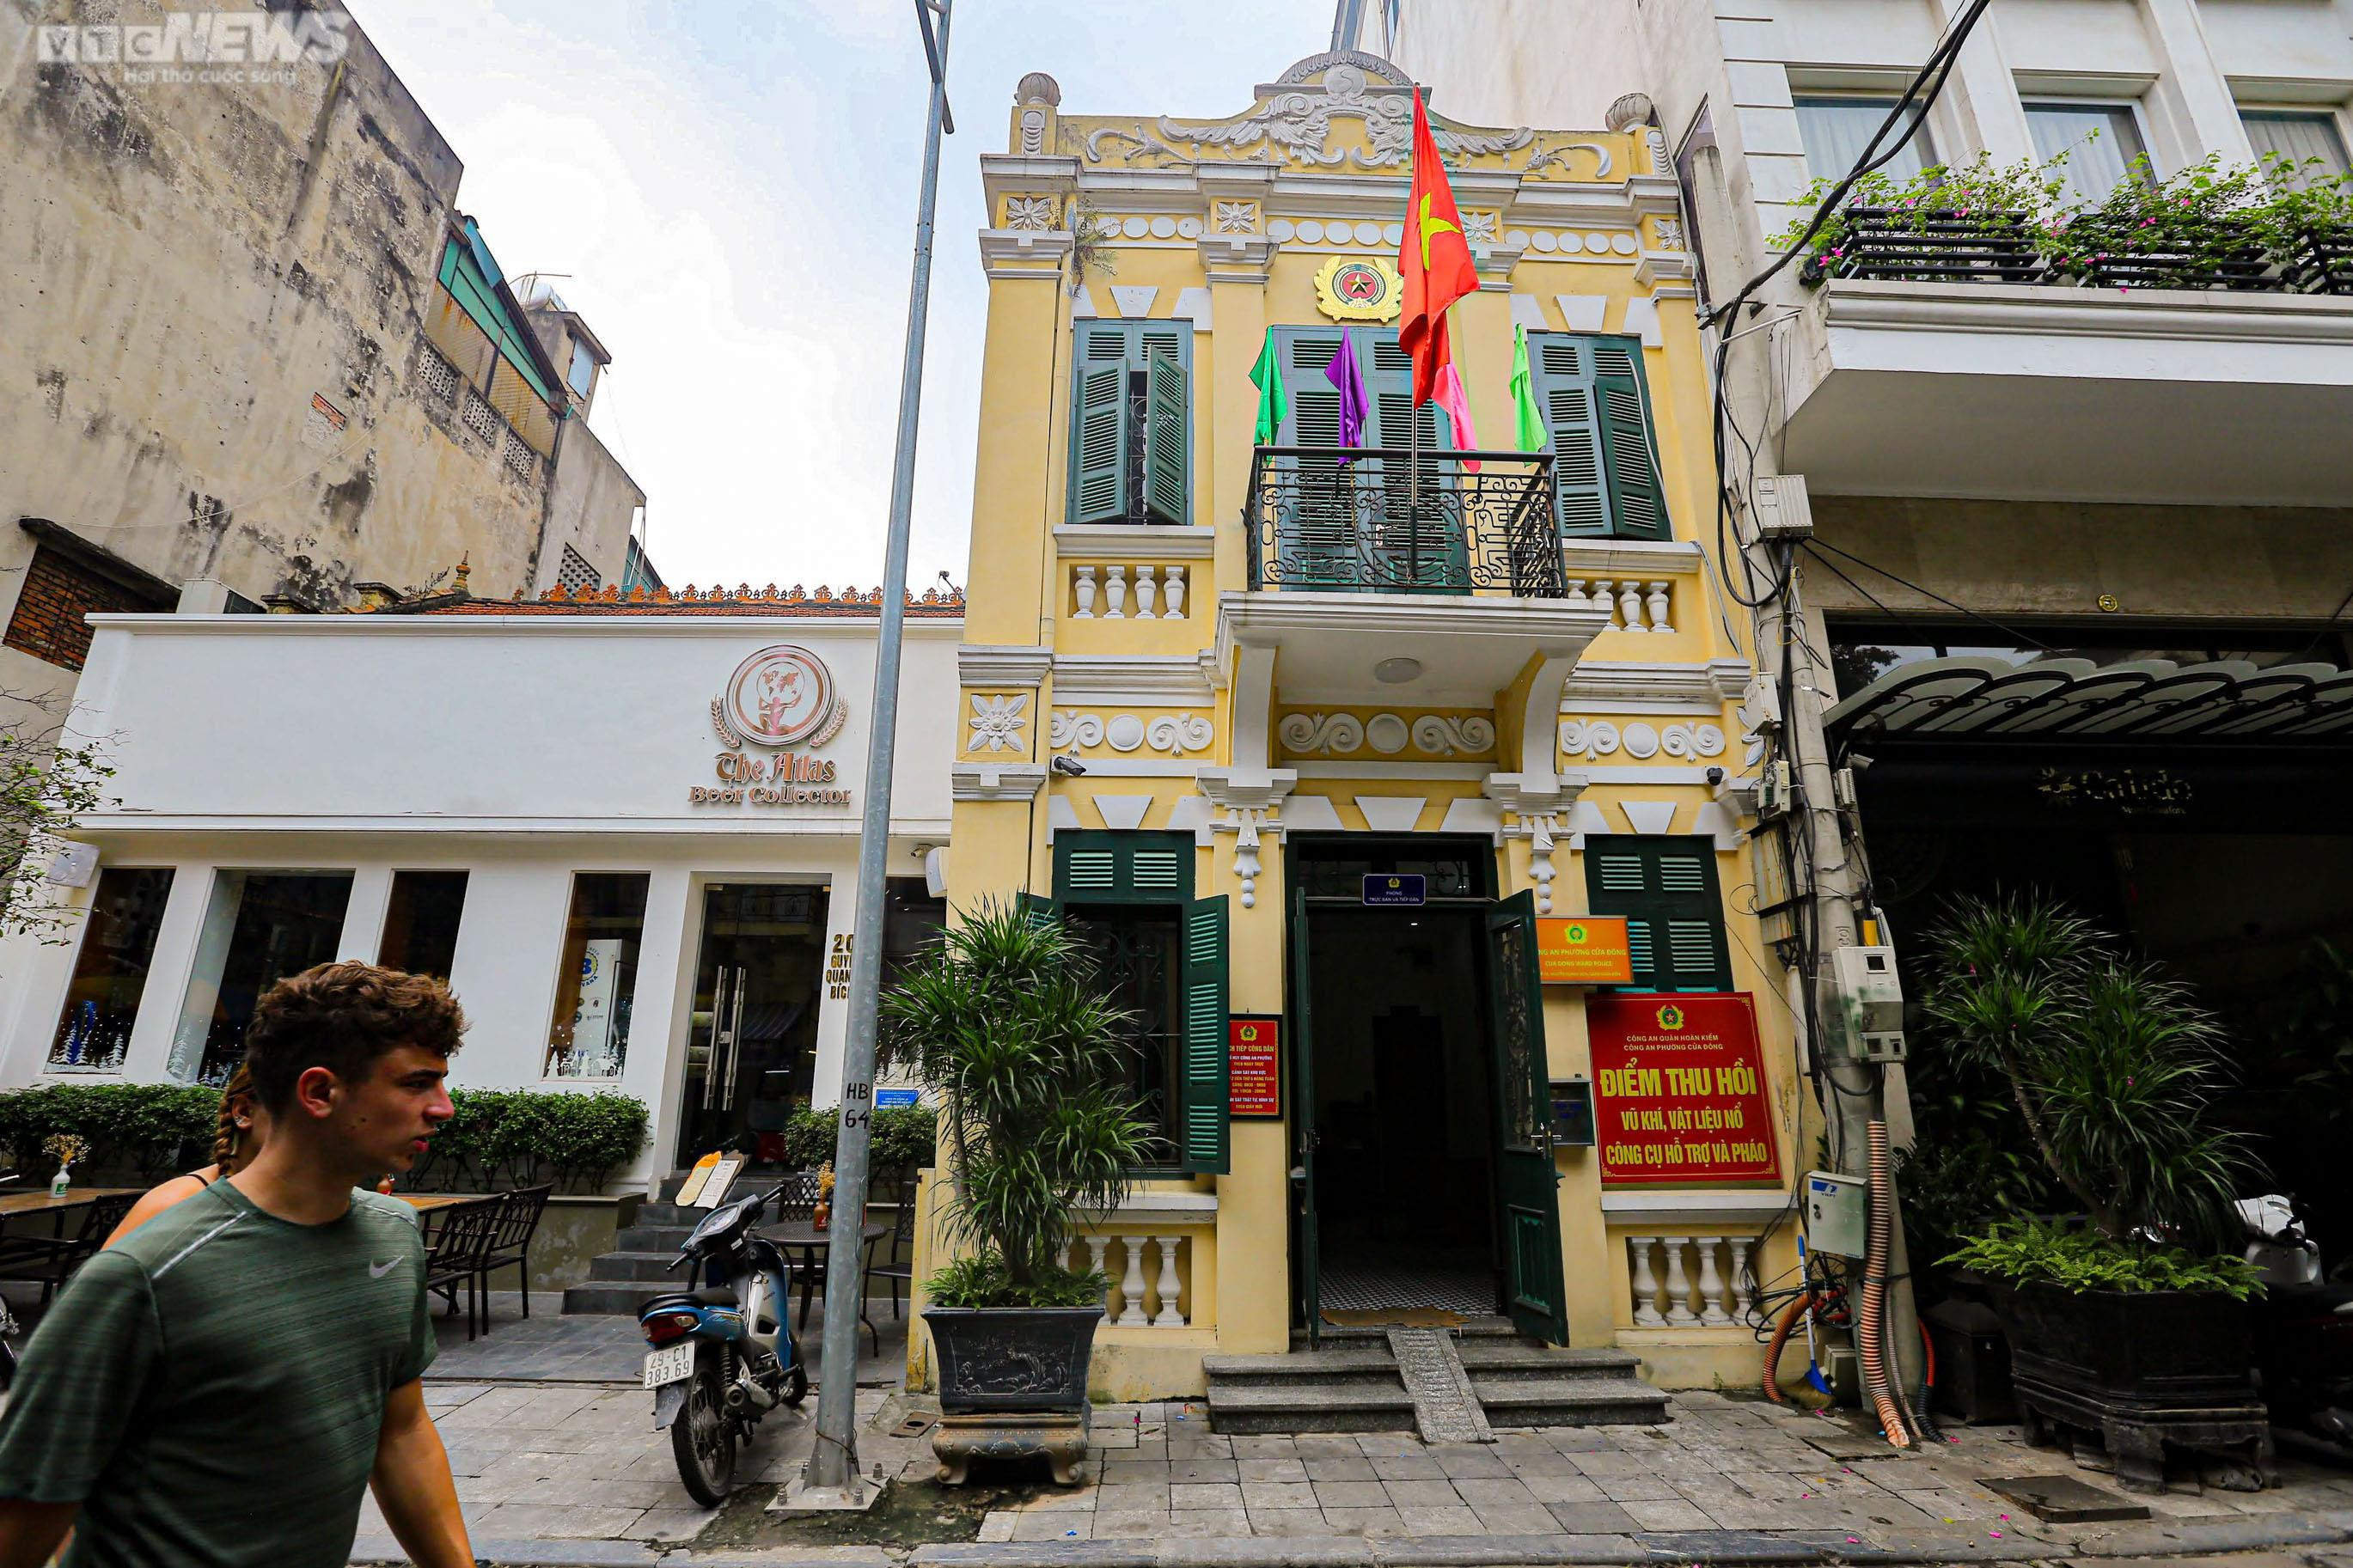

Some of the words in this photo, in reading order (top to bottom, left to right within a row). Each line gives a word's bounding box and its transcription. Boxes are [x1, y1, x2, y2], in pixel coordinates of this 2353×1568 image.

[714, 751, 766, 789] The
[688, 785, 745, 804] Beer
[749, 784, 853, 805] Collector
[829, 982, 849, 999] BÍC
[1599, 1058, 1663, 1097] ĐIỂM
[1665, 1067, 1712, 1096] THU
[1715, 1058, 1757, 1095] HỒI
[846, 1082, 869, 1101] HB
[844, 1108, 870, 1129] 64
[1621, 1107, 1639, 1131] VŨ
[1641, 1106, 1667, 1132] KHÍ,
[1668, 1106, 1692, 1134] VẬT
[1694, 1106, 1721, 1133] LIỆU
[1723, 1101, 1745, 1129] NỔ
[1605, 1141, 1643, 1165] CÔNG
[1644, 1144, 1663, 1168] CỤ
[1665, 1137, 1684, 1164] HỖ
[1684, 1141, 1711, 1168] TRỢ
[1711, 1138, 1729, 1163] VÀ
[1731, 1138, 1768, 1162] PHÁO
[646, 1360, 690, 1386] 383.69
